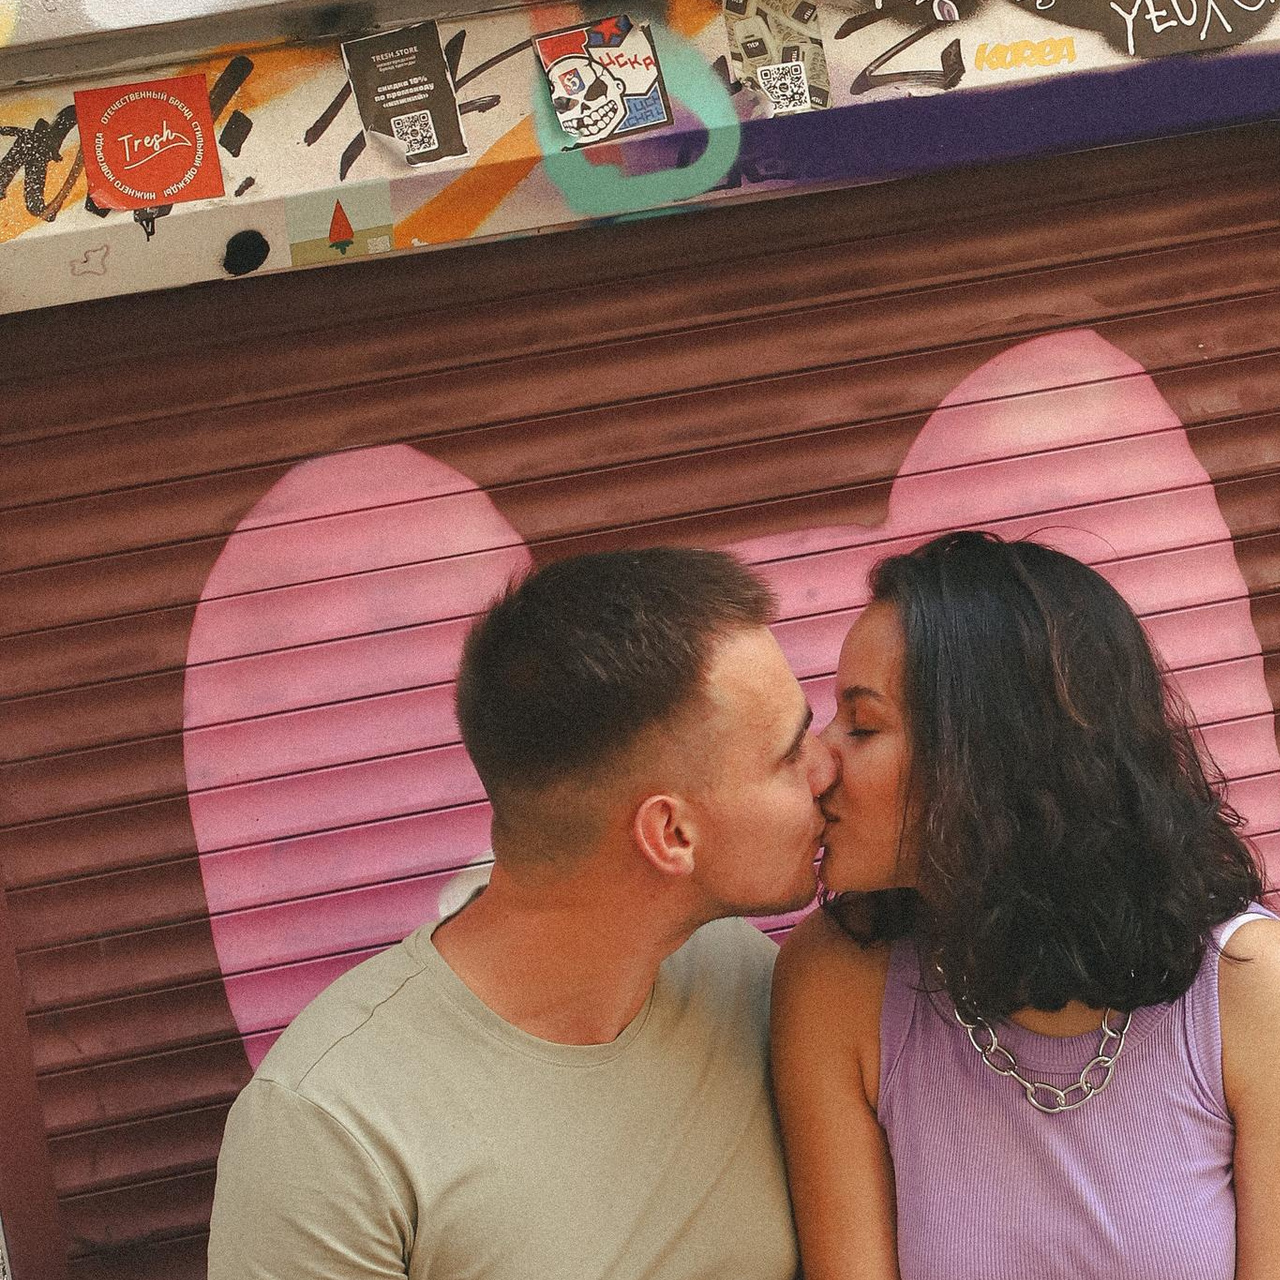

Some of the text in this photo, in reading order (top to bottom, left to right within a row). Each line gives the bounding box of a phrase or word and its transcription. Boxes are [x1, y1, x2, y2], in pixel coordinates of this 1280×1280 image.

[371, 46, 419, 62] TRESH.STORE
[374, 83, 435, 102] по промокоду
[377, 76, 428, 93] скидка 10%
[95, 91, 204, 200] ОТЕЧЕСТВЕННЫЙ БРЕНД СТИЛЬНОЙ ОДЕЖДЫ НИЖНЕГО НОВГОРОДА
[118, 120, 177, 162] Tresh
